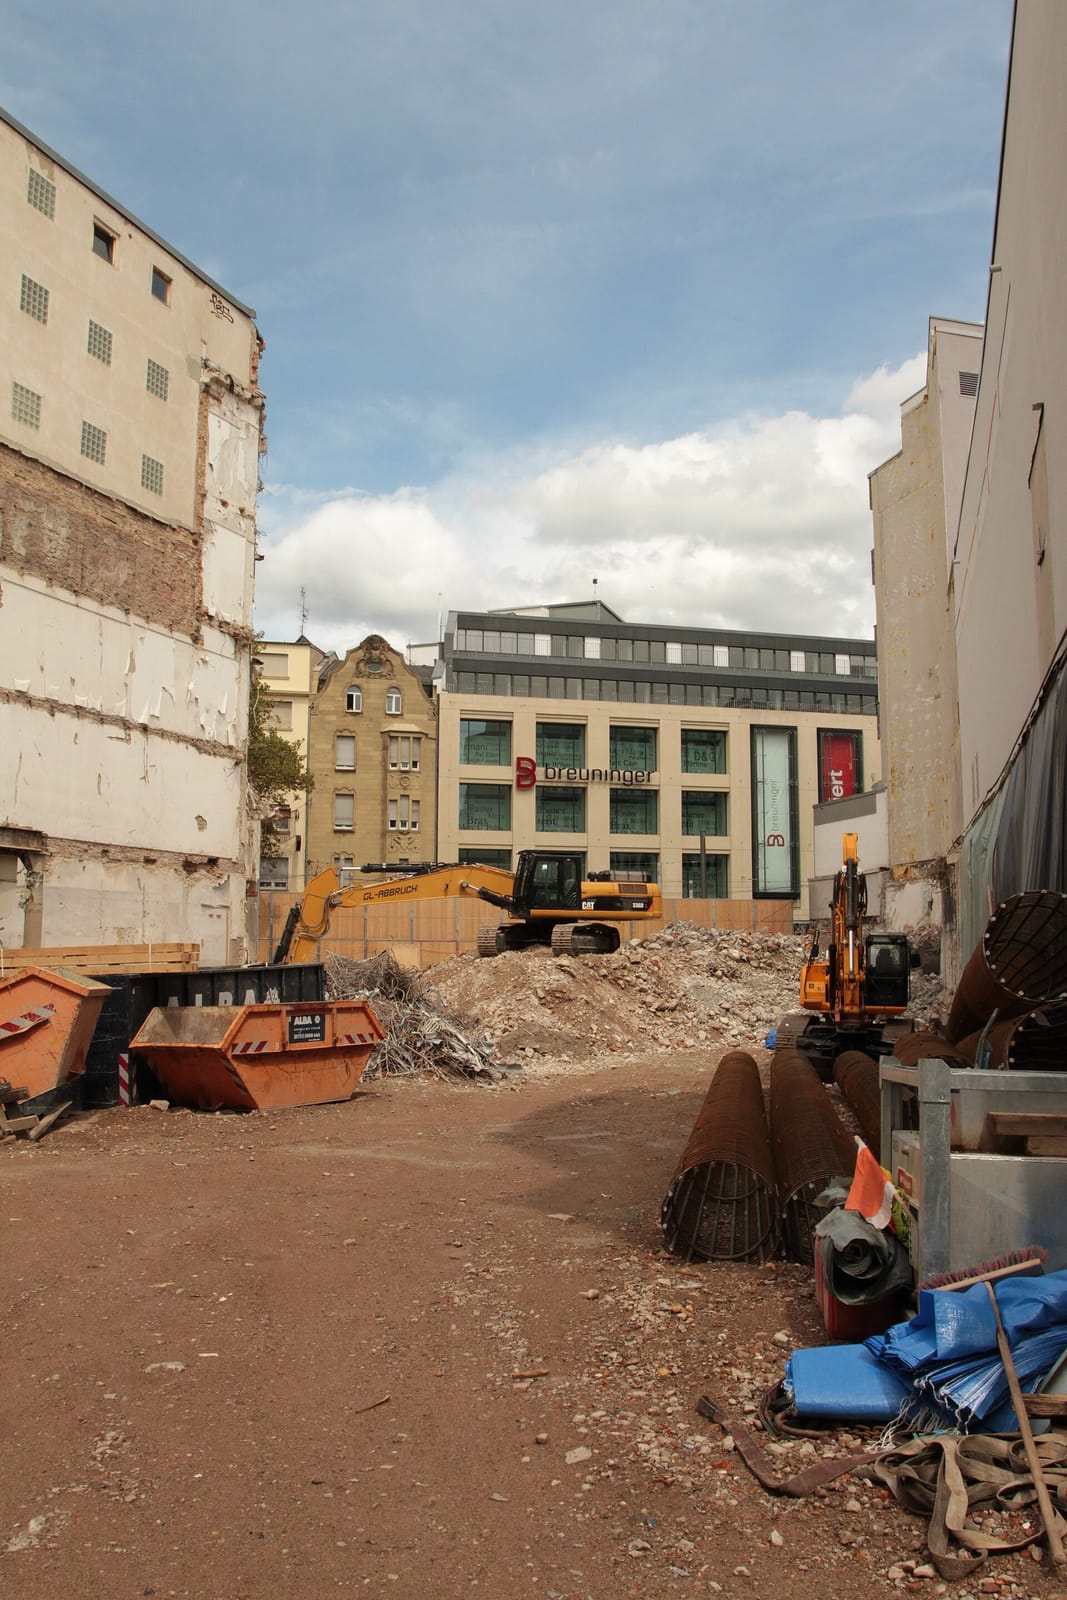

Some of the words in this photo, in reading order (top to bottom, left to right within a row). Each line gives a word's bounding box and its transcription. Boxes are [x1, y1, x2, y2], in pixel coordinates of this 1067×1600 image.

[545, 763, 657, 786] breuninger
[363, 885, 417, 901] GL-ABBRUCH
[582, 901, 595, 911] CAT
[293, 1015, 312, 1026] ALBA
